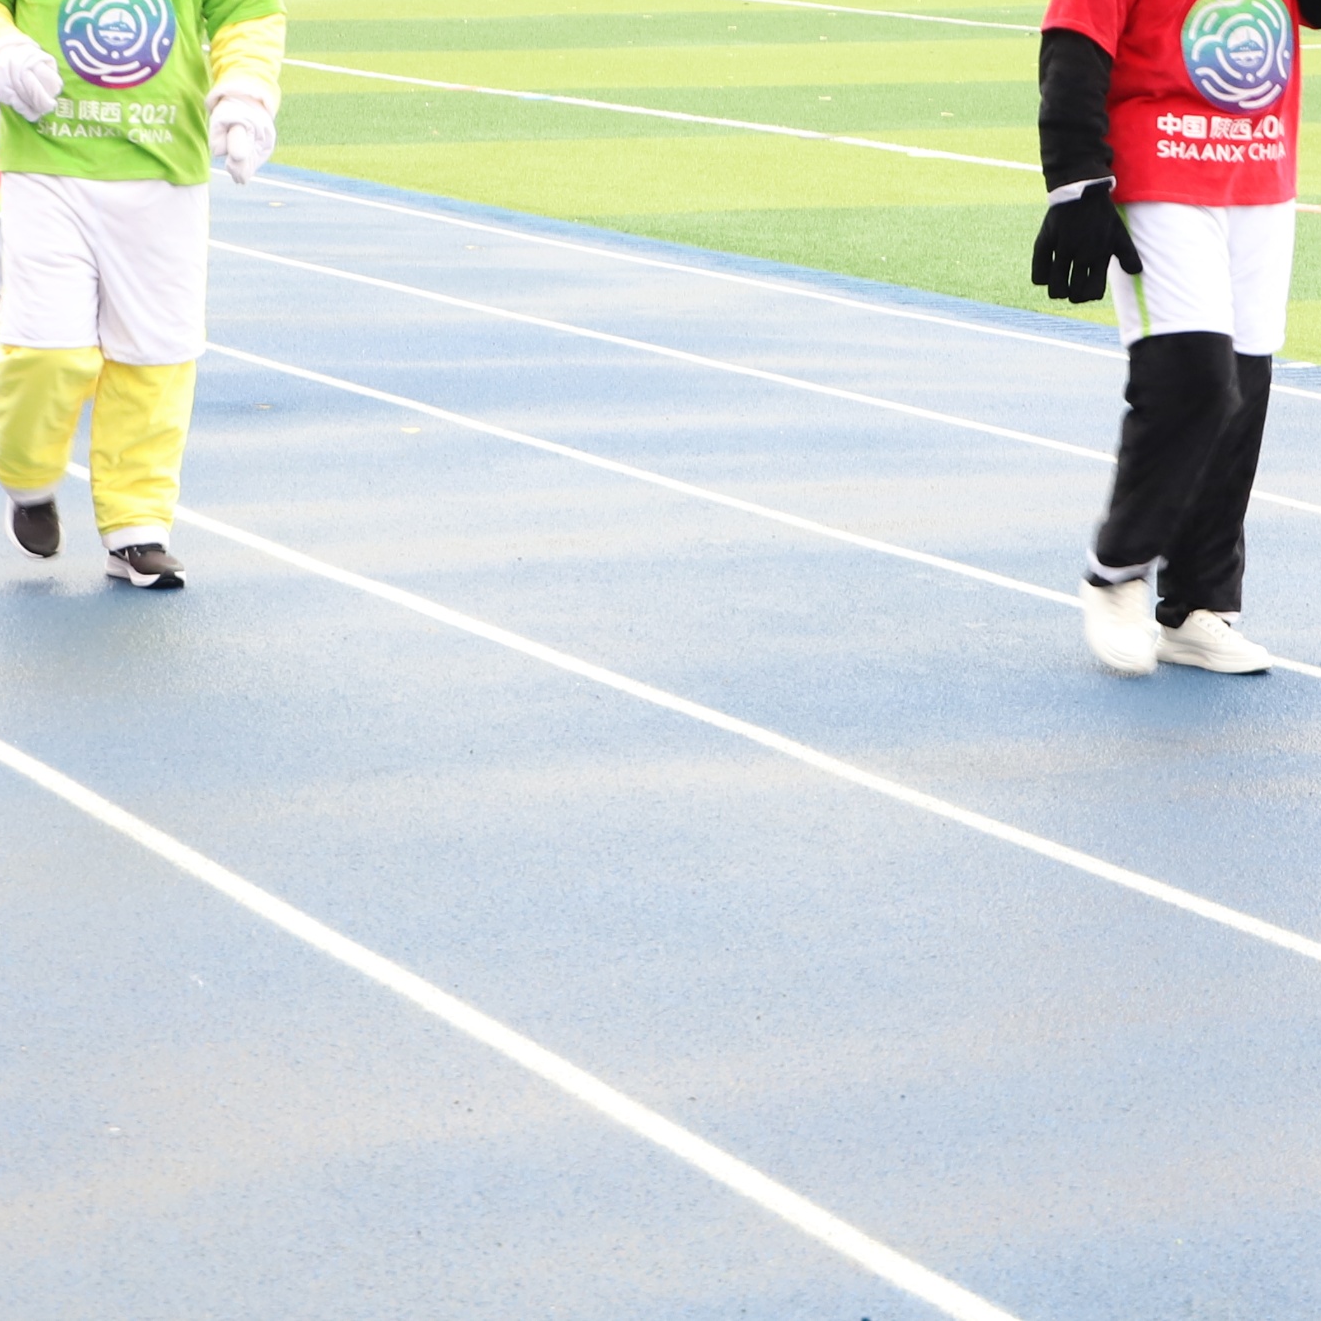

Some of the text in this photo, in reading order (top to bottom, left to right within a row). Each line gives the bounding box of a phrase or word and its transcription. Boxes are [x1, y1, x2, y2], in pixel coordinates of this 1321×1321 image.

[78, 100, 122, 124] 陕西
[128, 103, 177, 126] 2021
[127, 128, 173, 144] CHINA
[1156, 112, 1208, 139] 中国
[1157, 140, 1245, 162] SHAANX
